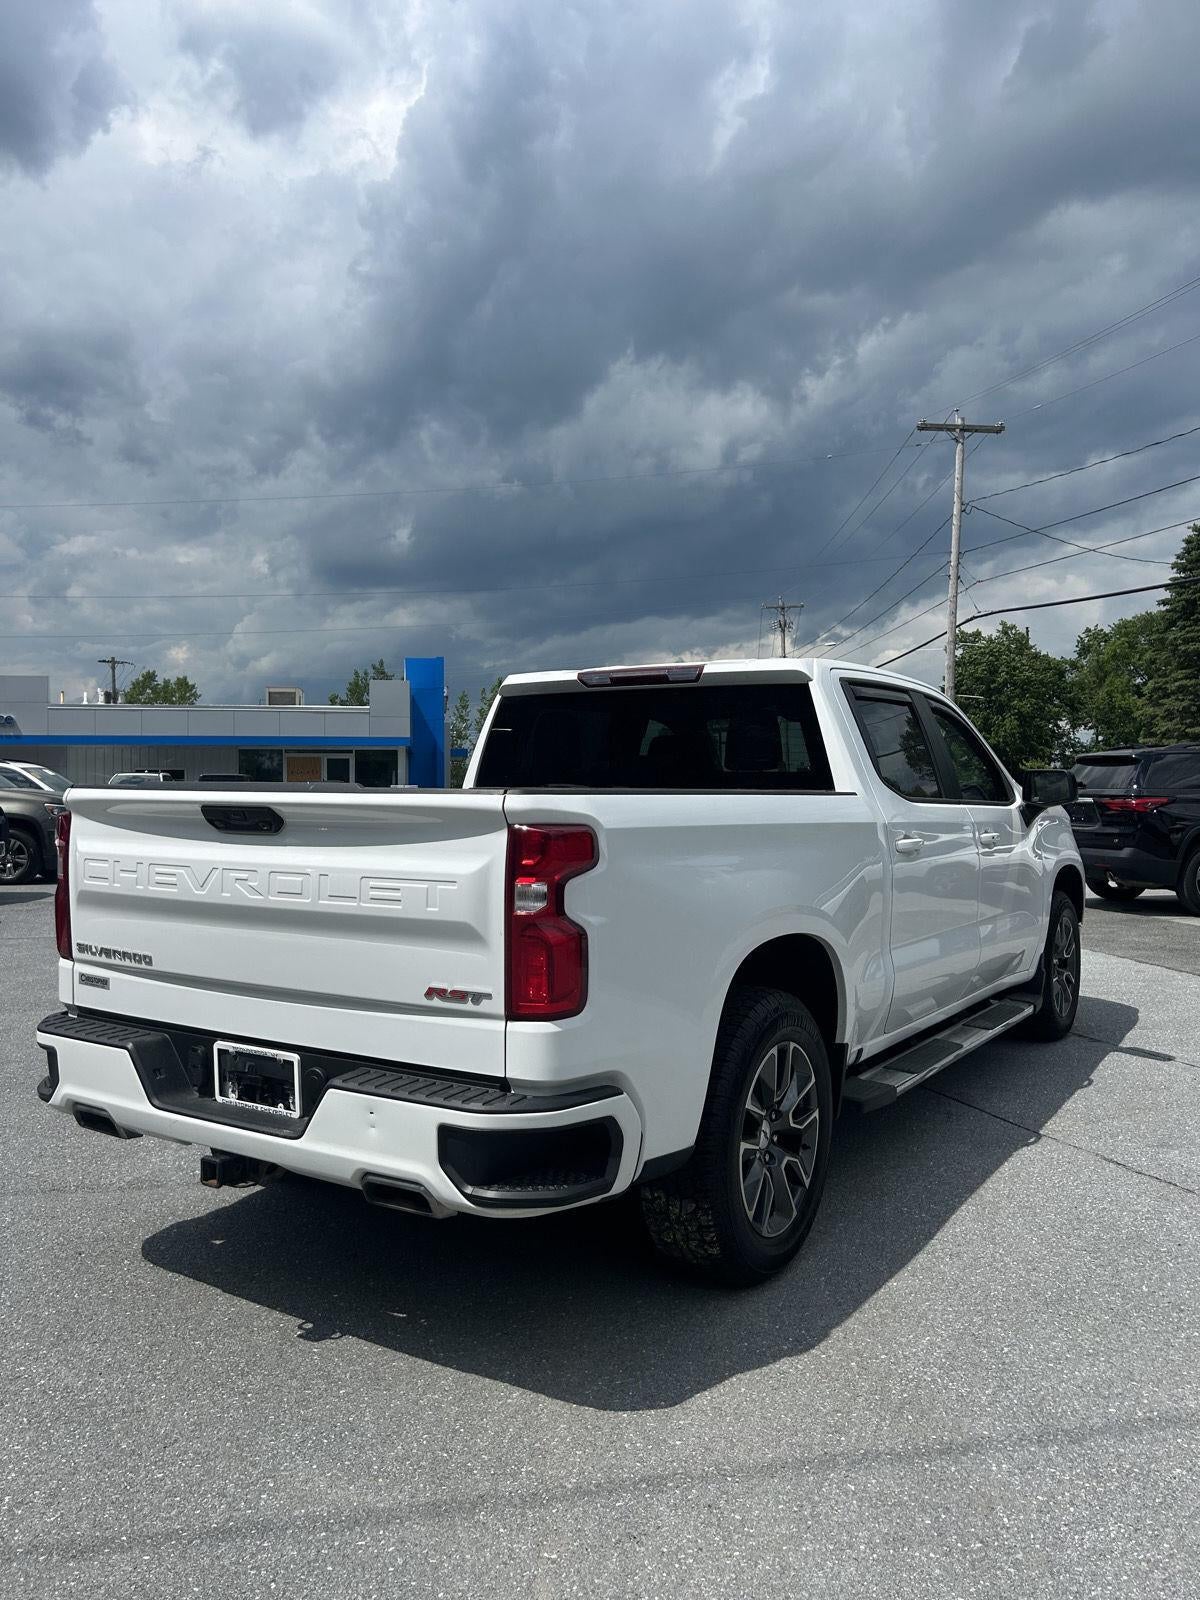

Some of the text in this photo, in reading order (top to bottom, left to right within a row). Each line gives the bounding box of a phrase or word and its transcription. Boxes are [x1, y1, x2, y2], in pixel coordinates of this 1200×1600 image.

[83, 857, 458, 911] CHEVROLET
[76, 942, 153, 967] SILVERADO
[424, 986, 493, 1006] RST
